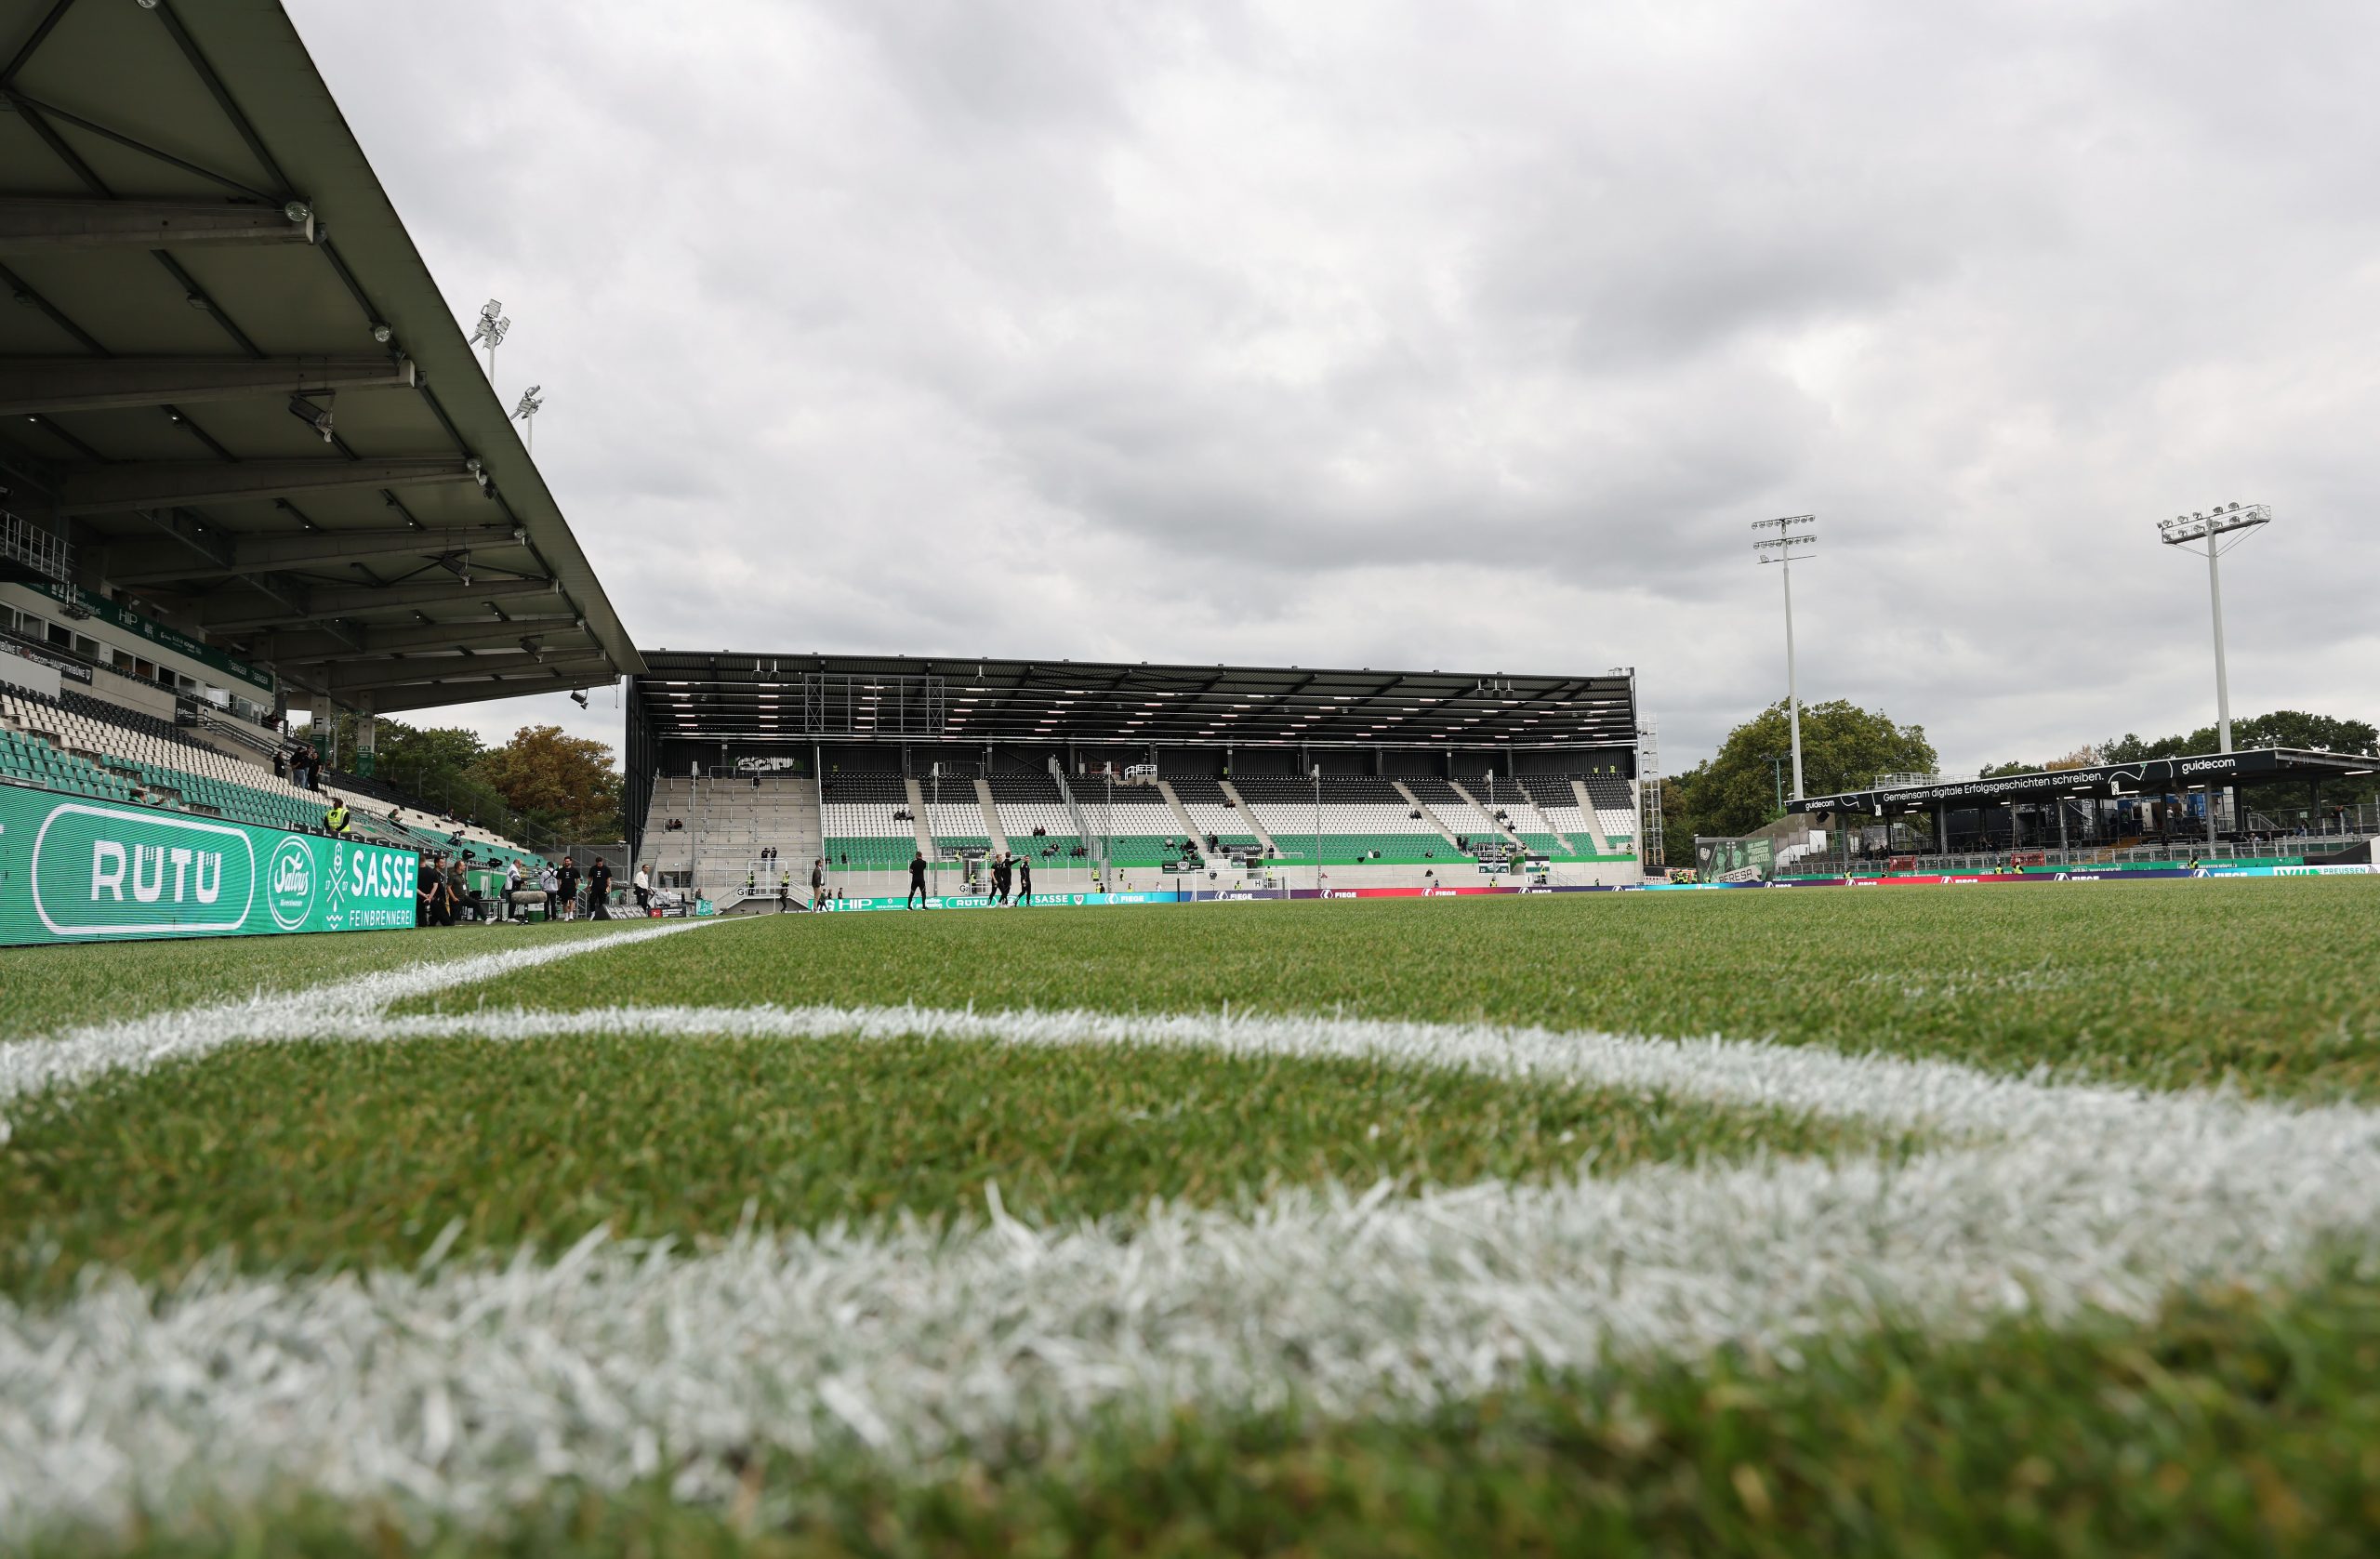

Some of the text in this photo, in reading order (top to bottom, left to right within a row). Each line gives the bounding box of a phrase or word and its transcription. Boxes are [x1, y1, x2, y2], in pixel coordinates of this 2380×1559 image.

[118, 608, 138, 626] HIP
[314, 718, 323, 729] F
[2182, 759, 2236, 774] guidecom
[1883, 772, 2104, 802] Gemeinsam digitale Erfolgsgeschichten schreiben.
[1805, 799, 1835, 812] guidecom
[91, 840, 222, 904] RÜTÜ
[351, 850, 416, 898] SASSE
[839, 899, 873, 909] HIP
[350, 910, 412, 927] FEINBRENNEREI
